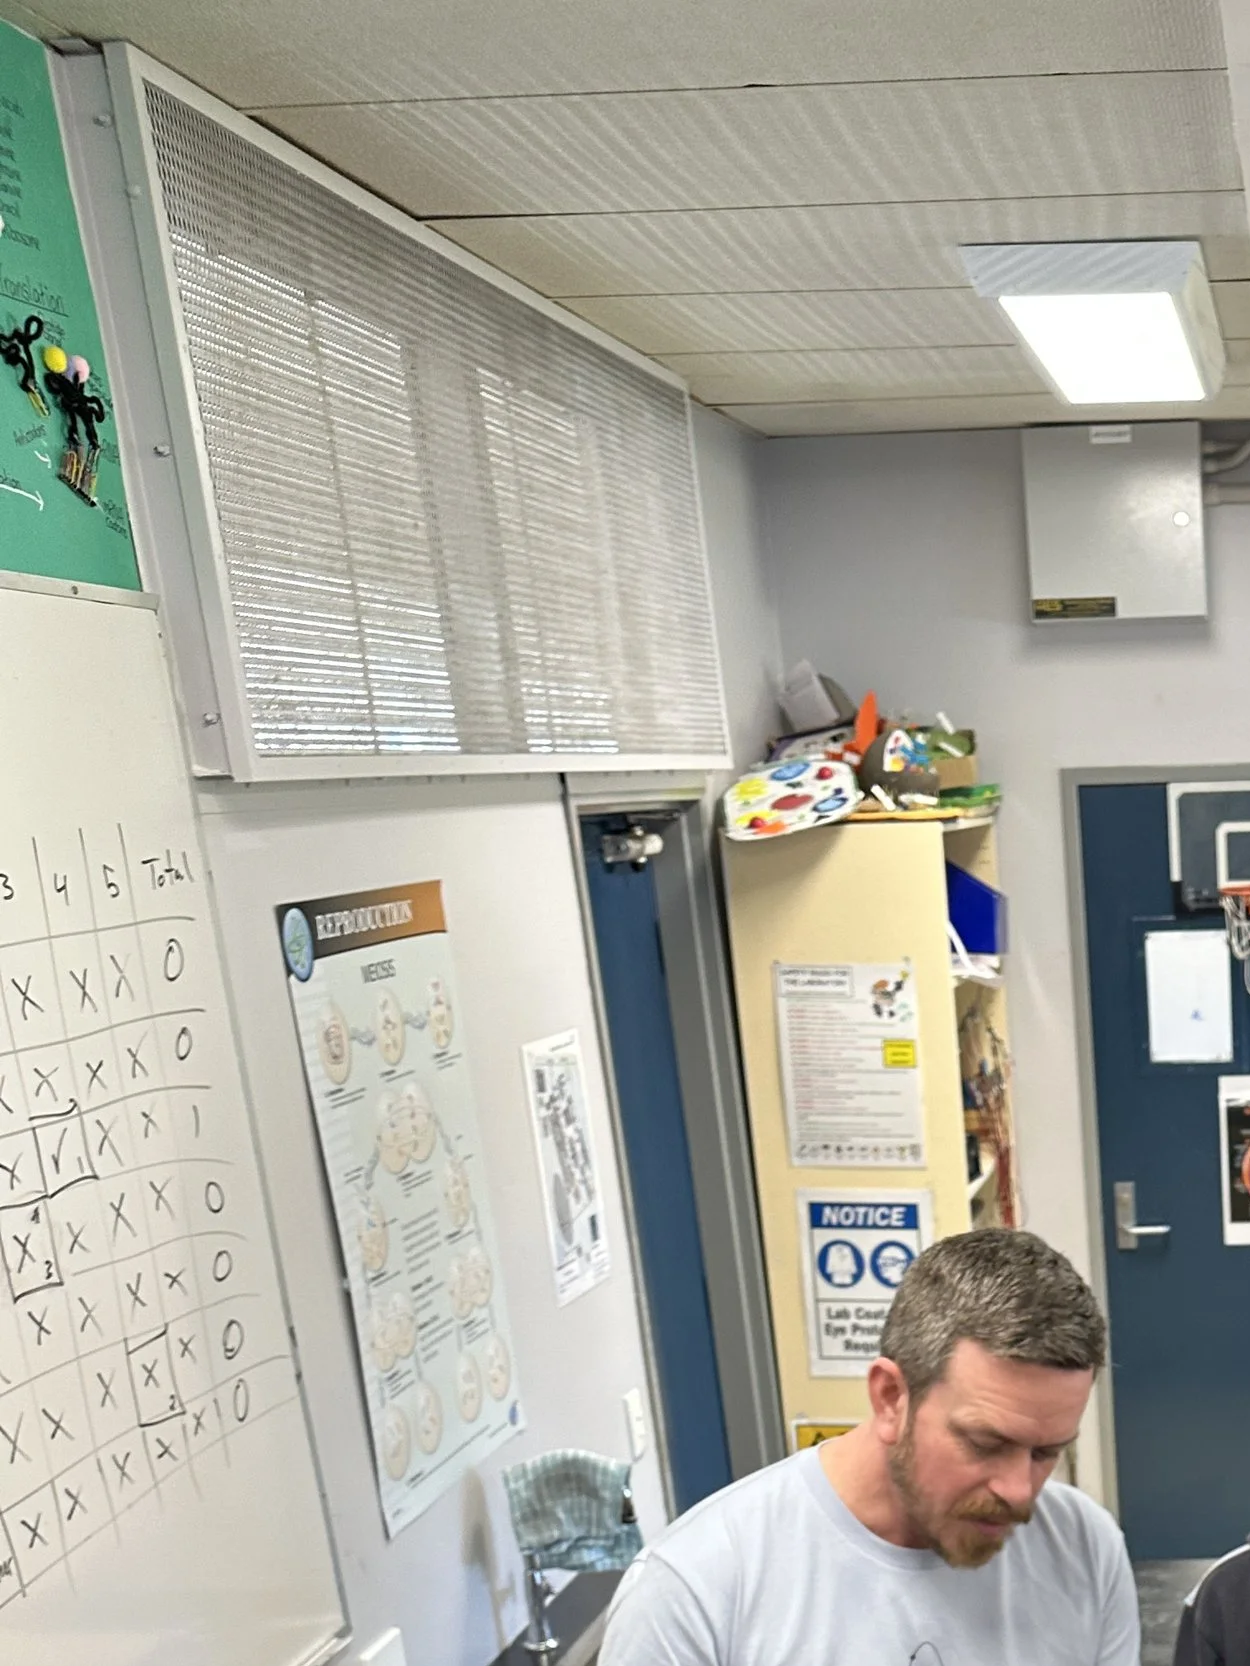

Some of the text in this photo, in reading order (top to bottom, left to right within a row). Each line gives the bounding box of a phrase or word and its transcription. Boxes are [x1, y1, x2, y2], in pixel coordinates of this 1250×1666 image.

[54, 873, 69, 906] 4
[103, 864, 120, 898] 5
[141, 849, 194, 890] Total
[821, 1205, 907, 1227] NOTICE
[826, 1307, 887, 1320] Lab Coat
[824, 1323, 846, 1338] Eye
